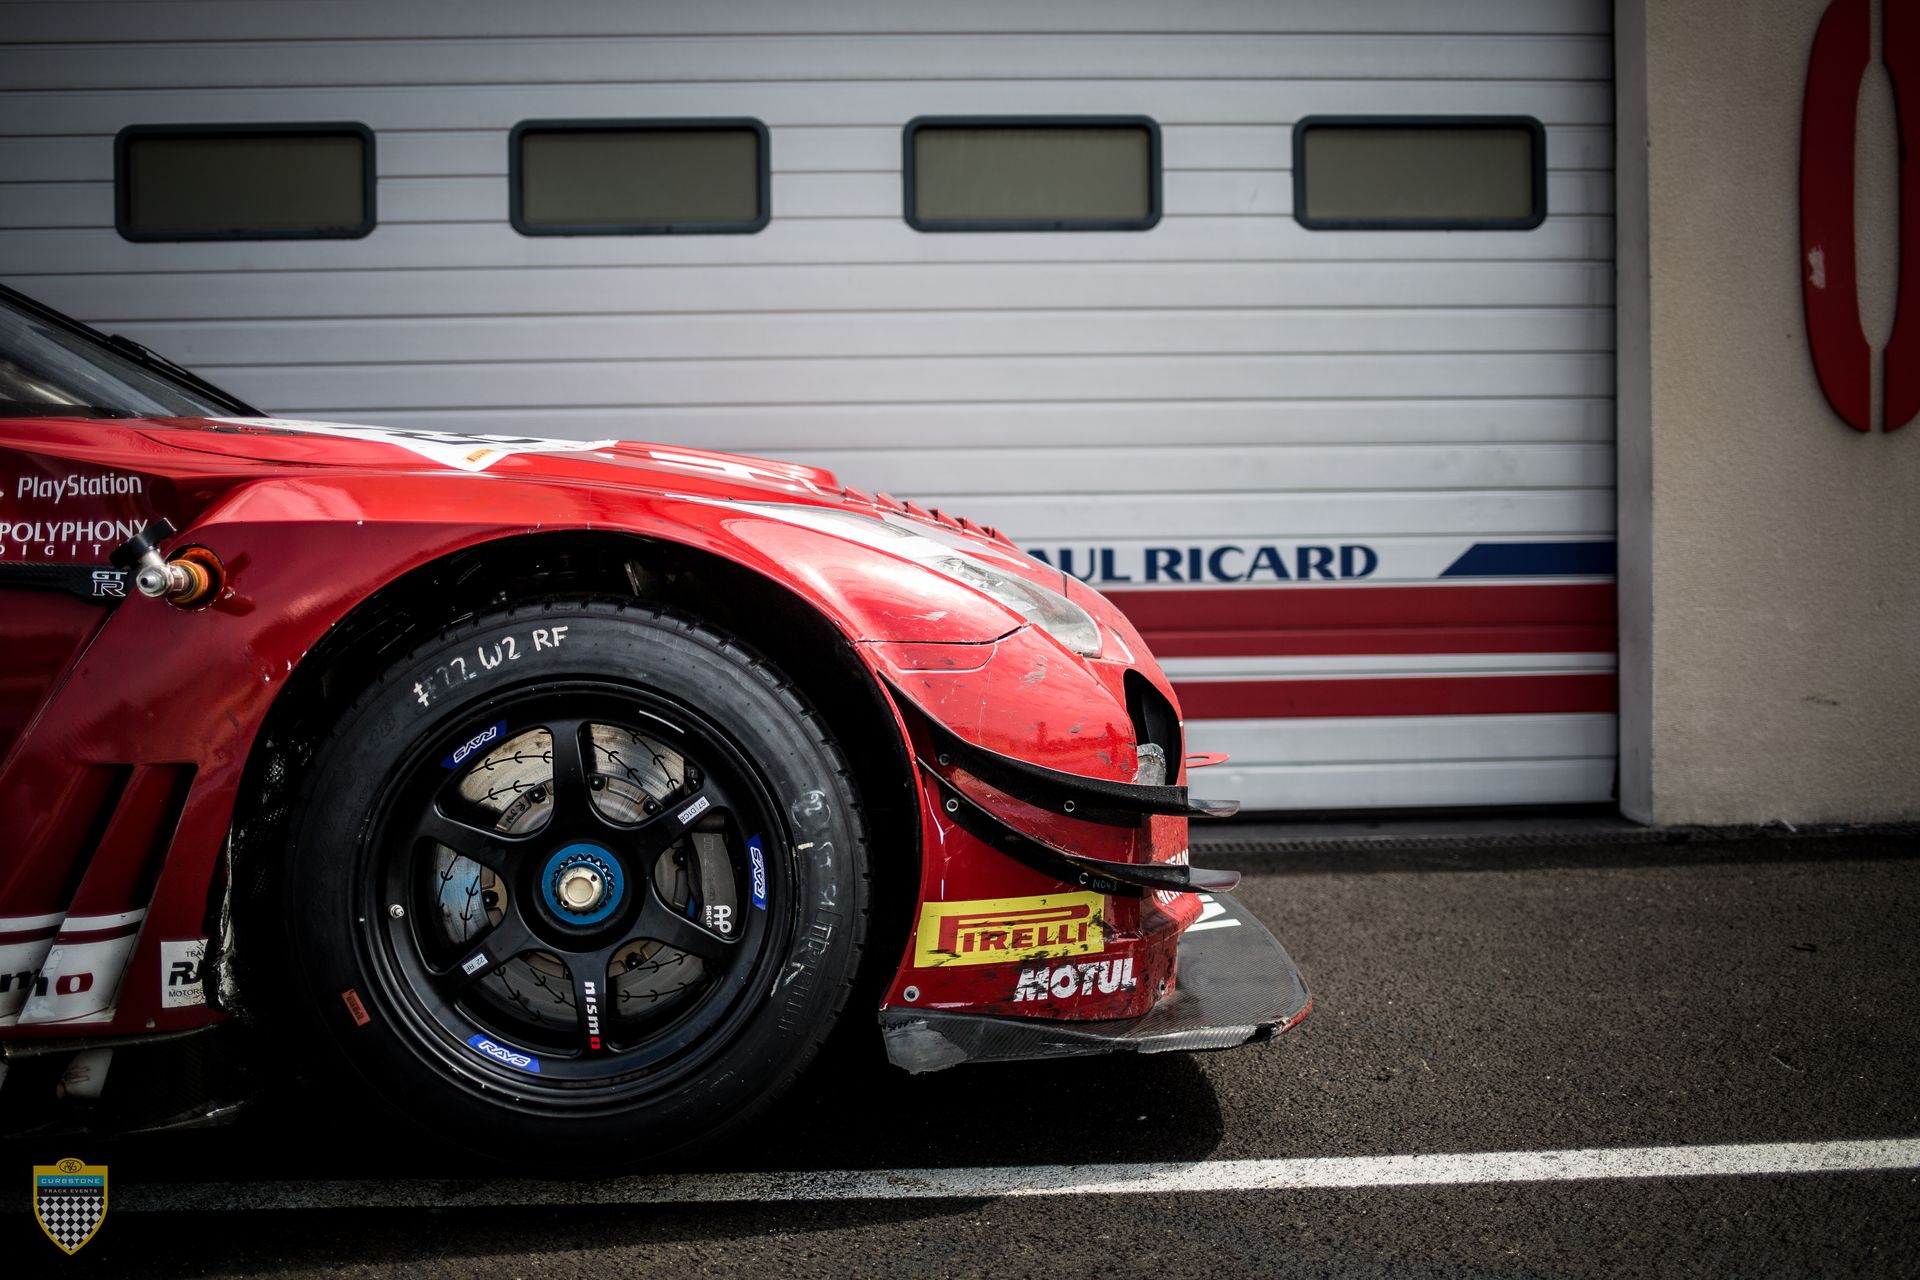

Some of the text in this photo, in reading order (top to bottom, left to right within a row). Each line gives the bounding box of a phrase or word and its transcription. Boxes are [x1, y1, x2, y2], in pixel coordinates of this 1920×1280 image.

[17, 472, 142, 504] PlayStation
[1144, 545, 1379, 583] RICARD
[478, 636, 521, 670] W2
[532, 625, 569, 652] RF
[452, 725, 497, 764] RAYS
[750, 846, 766, 899] RAYS
[705, 905, 713, 928] RACIN
[937, 903, 1091, 955] PIRELLI
[185, 950, 204, 958] TEA
[1013, 957, 1137, 1003] MOTUL
[583, 981, 601, 1050] nismo
[478, 1040, 531, 1069] RAYS
